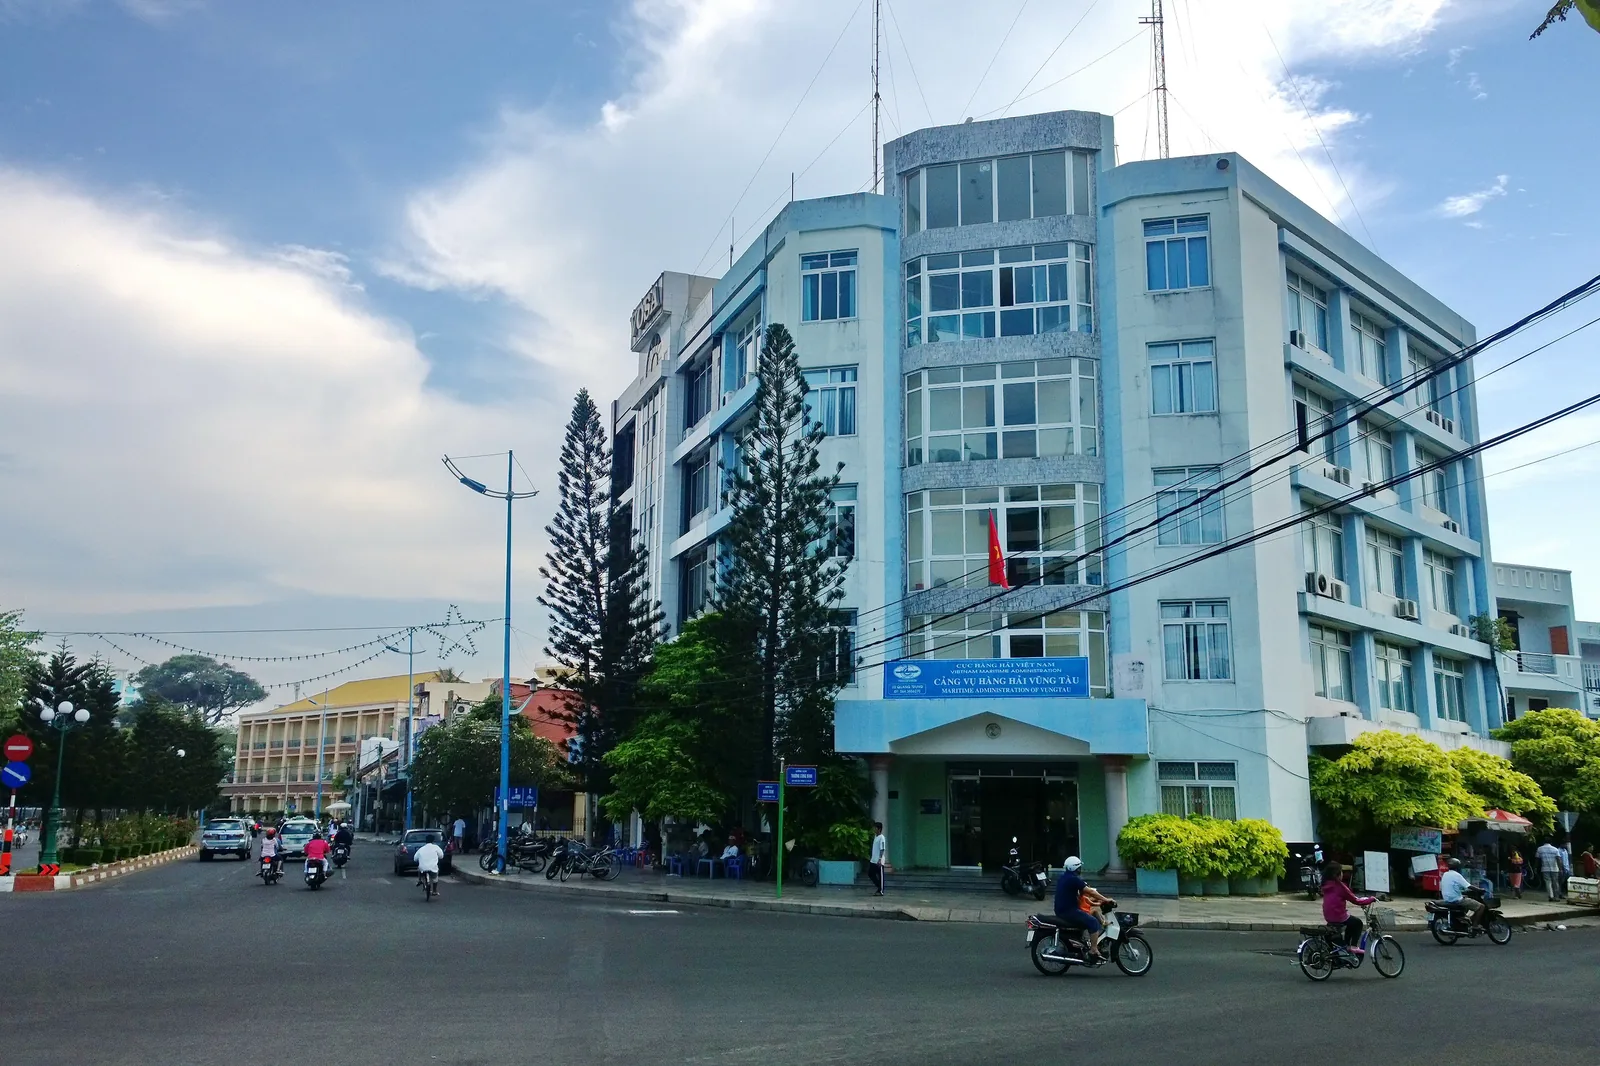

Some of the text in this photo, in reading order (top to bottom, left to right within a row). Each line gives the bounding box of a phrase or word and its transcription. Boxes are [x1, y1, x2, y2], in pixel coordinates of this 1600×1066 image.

[933, 674, 1080, 687] CẢNG VỤ HÀNG HẢI VŨNG TÀU
